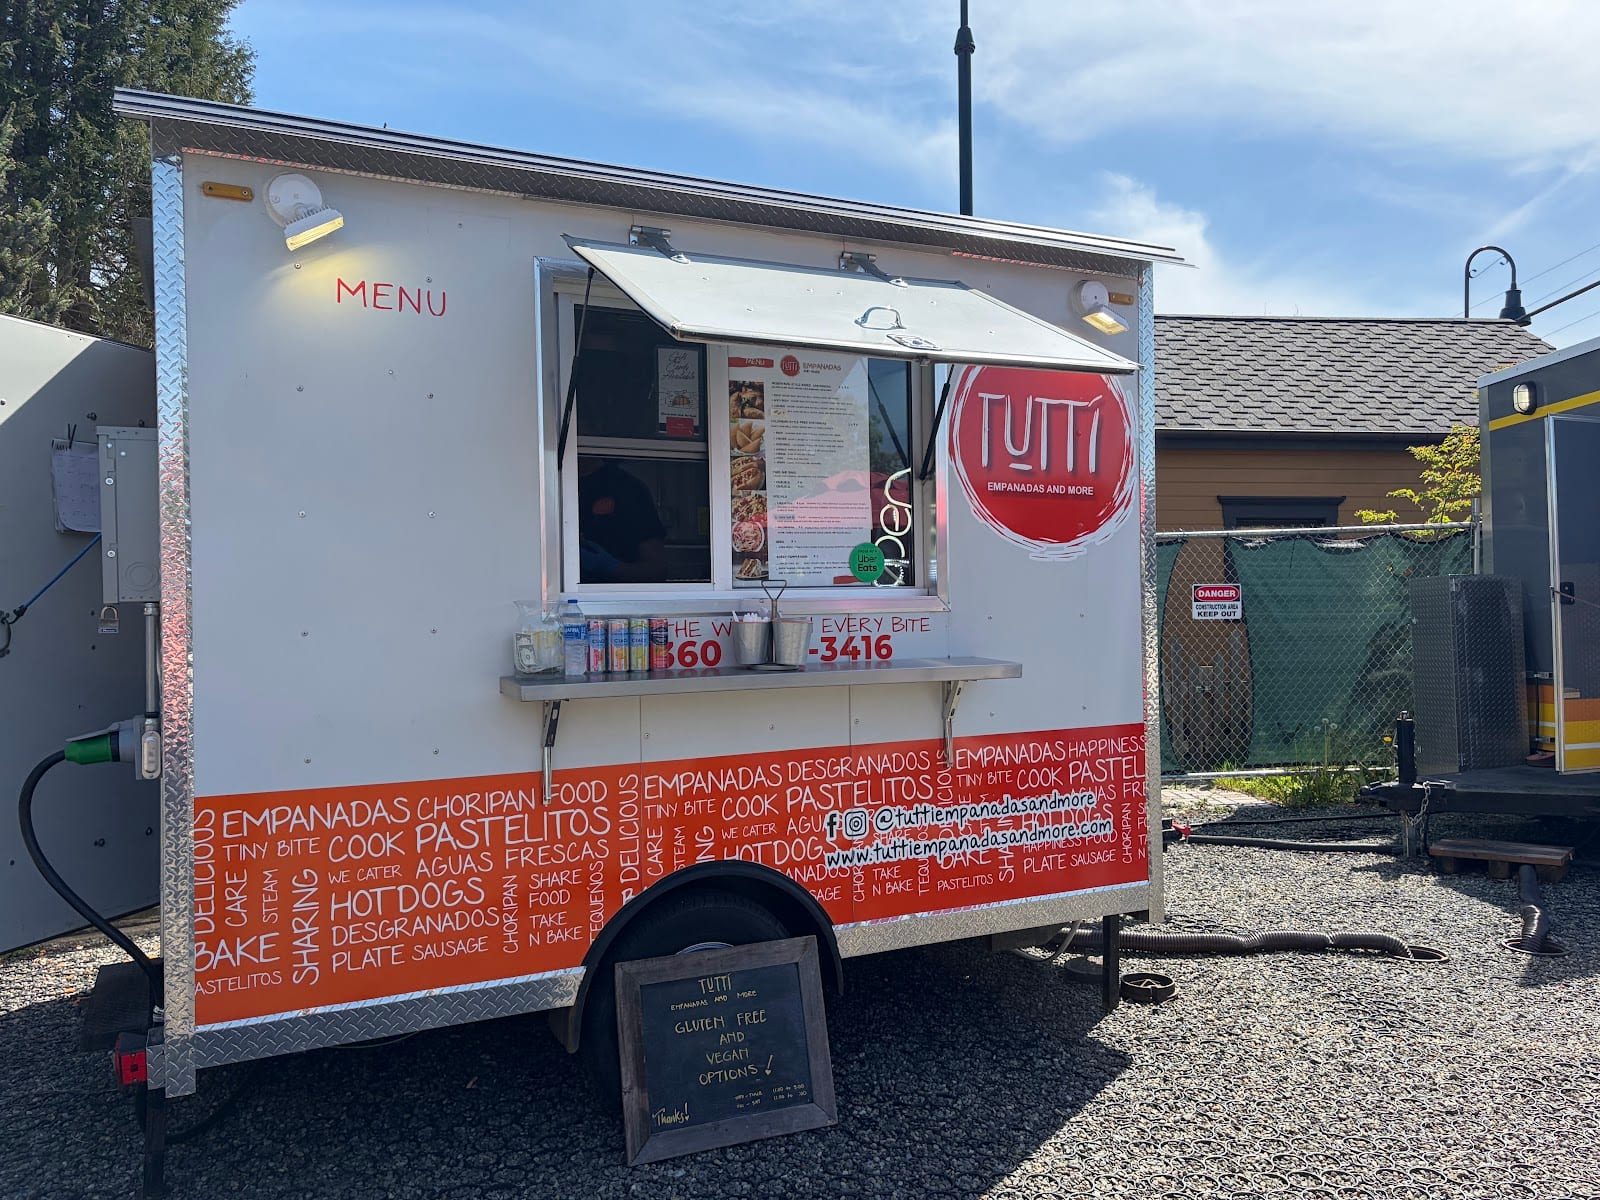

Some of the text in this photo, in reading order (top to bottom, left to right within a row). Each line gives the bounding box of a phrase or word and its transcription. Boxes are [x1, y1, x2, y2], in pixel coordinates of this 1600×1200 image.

[336, 277, 446, 317] MENU
[987, 481, 1094, 496] EMPANADAS AND MORE
[857, 554, 878, 563] Uber
[857, 563, 878, 572] Eats
[1198, 589, 1236, 598] DANGER
[822, 616, 931, 633] EVERY BITE
[956, 735, 1146, 770] EMPANADAS HAPPINESS
[644, 752, 931, 800] EMPANADAS DESGRANADOS
[956, 769, 1014, 788] TINY BITE
[1016, 766, 1064, 790] COOK
[644, 799, 717, 820] TINY BITE
[721, 774, 934, 821] COOK PASTELITOS
[222, 797, 411, 839] EMPANADAS
[417, 788, 536, 821] CHORIPAN
[875, 791, 1096, 832] @tuttiempanadasandmore
[328, 806, 611, 863] COOK PASTELITOS
[618, 773, 640, 884] DELICIOUS
[721, 822, 778, 840] WE CATER
[1121, 803, 1133, 864] CHORIPAN
[222, 837, 321, 862] TINY BITE
[646, 825, 664, 876] CARE
[827, 819, 1112, 867] www.tuttiempanadasandmore.com
[415, 838, 610, 879] AGUAS FRESCAS
[1023, 849, 1117, 874] PLATE SAUSAGE
[328, 864, 403, 885] WE CATER
[529, 869, 583, 890] SHARE
[872, 866, 902, 881] TAKE
[937, 873, 994, 891] PASTELITOS
[225, 869, 247, 927] CARE
[262, 868, 279, 924] STEAM
[529, 889, 571, 908] FOOD
[872, 878, 914, 896] N BAKE
[331, 906, 500, 947] DESGRANADOS
[502, 874, 519, 954] CHORIPAN
[529, 911, 567, 929] TAKE
[291, 868, 320, 986] SHARING
[529, 926, 584, 947] N BAKE
[194, 932, 281, 973] BAKE
[332, 936, 489, 974] PLATE SAUSAGE
[194, 970, 283, 996] ASTELITOS
[670, 990, 758, 1011] EMPANADAS AND MORE
[674, 1009, 768, 1034] GLUTEN FREE
[719, 1031, 745, 1046] AND
[705, 1047, 750, 1065] VEGAN
